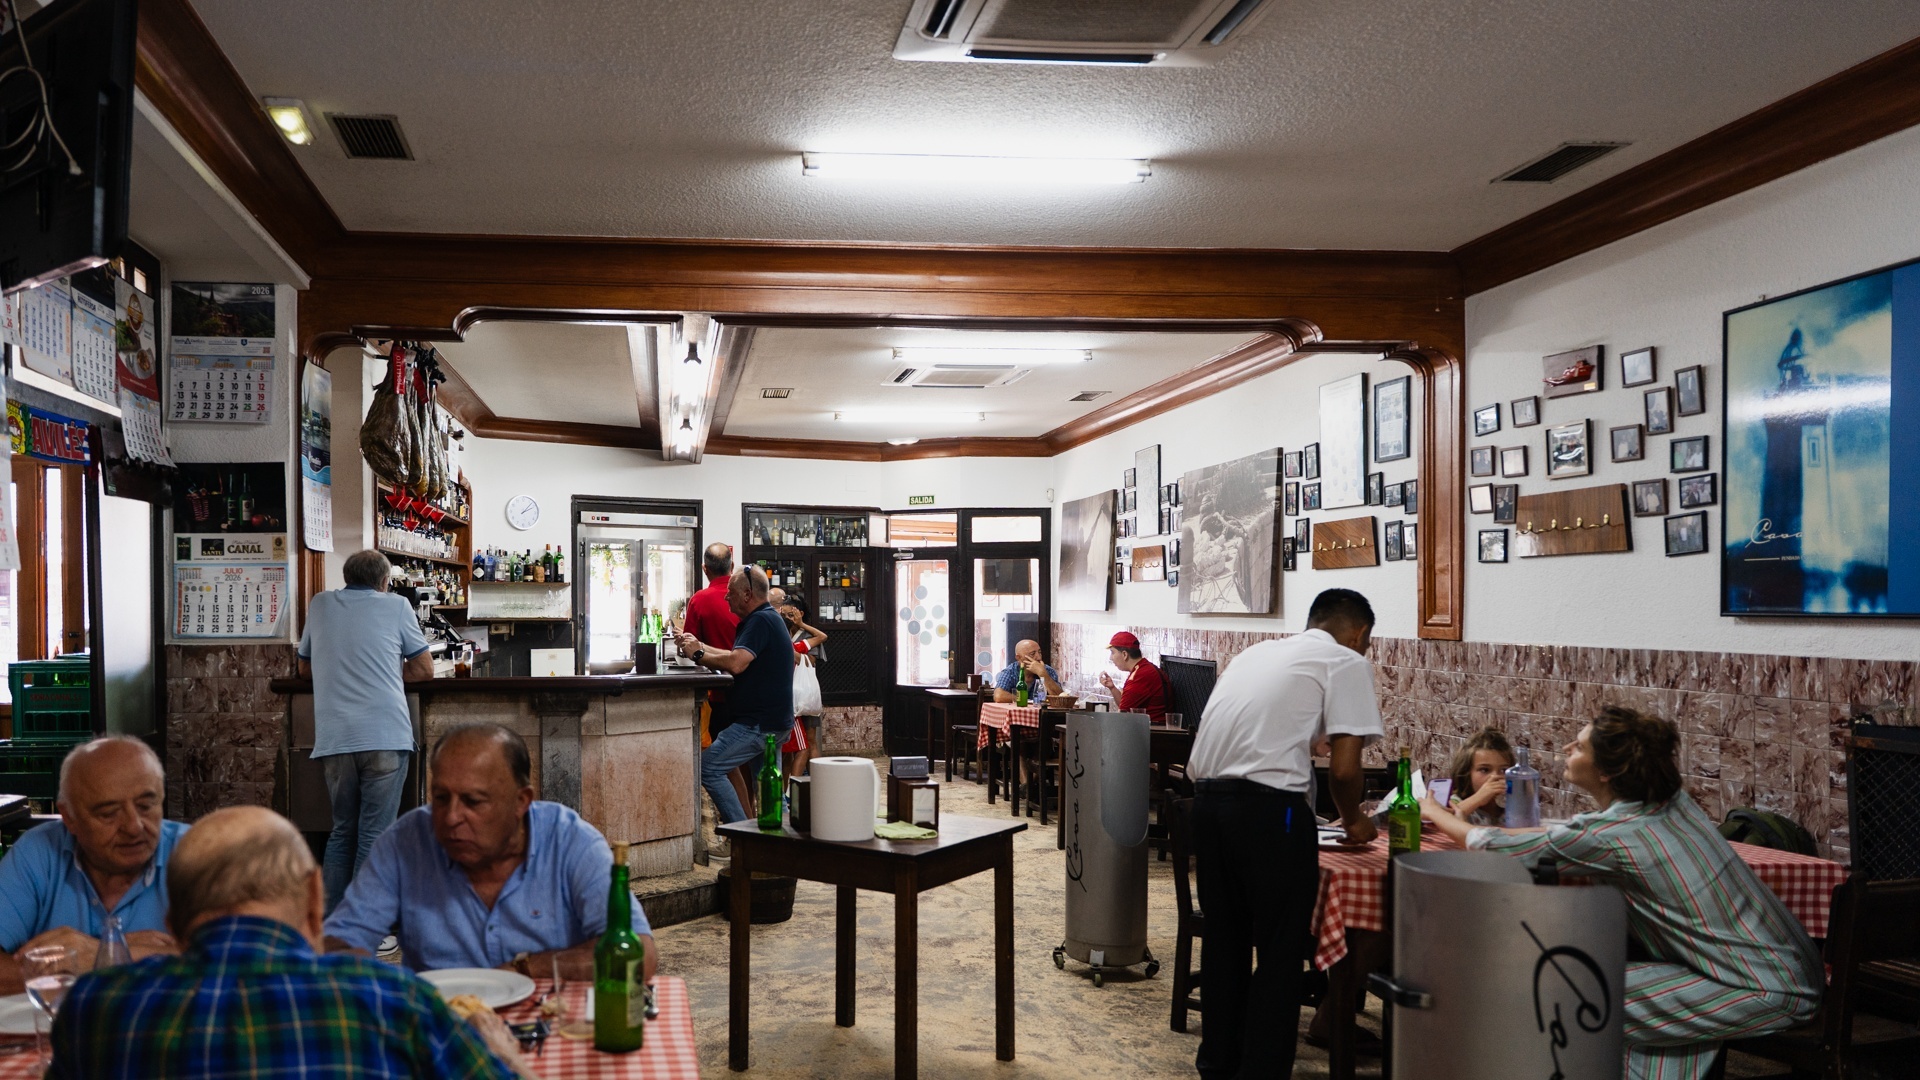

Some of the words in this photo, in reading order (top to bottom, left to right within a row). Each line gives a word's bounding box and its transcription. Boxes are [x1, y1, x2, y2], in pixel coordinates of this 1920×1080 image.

[252, 286, 270, 295] 2026
[220, 372, 224, 380] 2
[206, 382, 210, 390] 8
[220, 382, 224, 390] 9
[31, 416, 86, 461] AVILÉS
[910, 496, 933, 504] SALIDA
[227, 545, 264, 554] CANAL
[215, 584, 218, 593] 1
[229, 584, 233, 593] 2
[243, 585, 247, 593] 3
[256, 584, 260, 593] 4
[272, 584, 275, 592] 5
[184, 595, 188, 603] 6
[199, 595, 203, 603] 7
[214, 595, 218, 603] 8
[229, 595, 233, 603] 9
[242, 595, 248, 603] 10
[256, 595, 262, 603] 11
[271, 595, 277, 603] 12
[183, 605, 190, 613] 13
[198, 605, 204, 613] 14
[213, 605, 219, 613] 15
[227, 605, 234, 613] 16
[242, 605, 248, 613] 17
[256, 605, 262, 613] 18
[271, 605, 277, 613] 19
[182, 614, 190, 623] 20
[197, 614, 204, 623] 21
[212, 614, 219, 623] 22
[227, 614, 234, 623] 23
[241, 614, 248, 623] 24
[256, 614, 263, 623] 25
[182, 625, 189, 633] 27
[197, 625, 204, 633] 28
[212, 625, 219, 633] 29
[227, 625, 234, 633] 30
[242, 625, 247, 633] 31
[1066, 731, 1085, 789] Lin
[1067, 798, 1086, 893] Casa
[1520, 920, 1611, 1080] Ca
